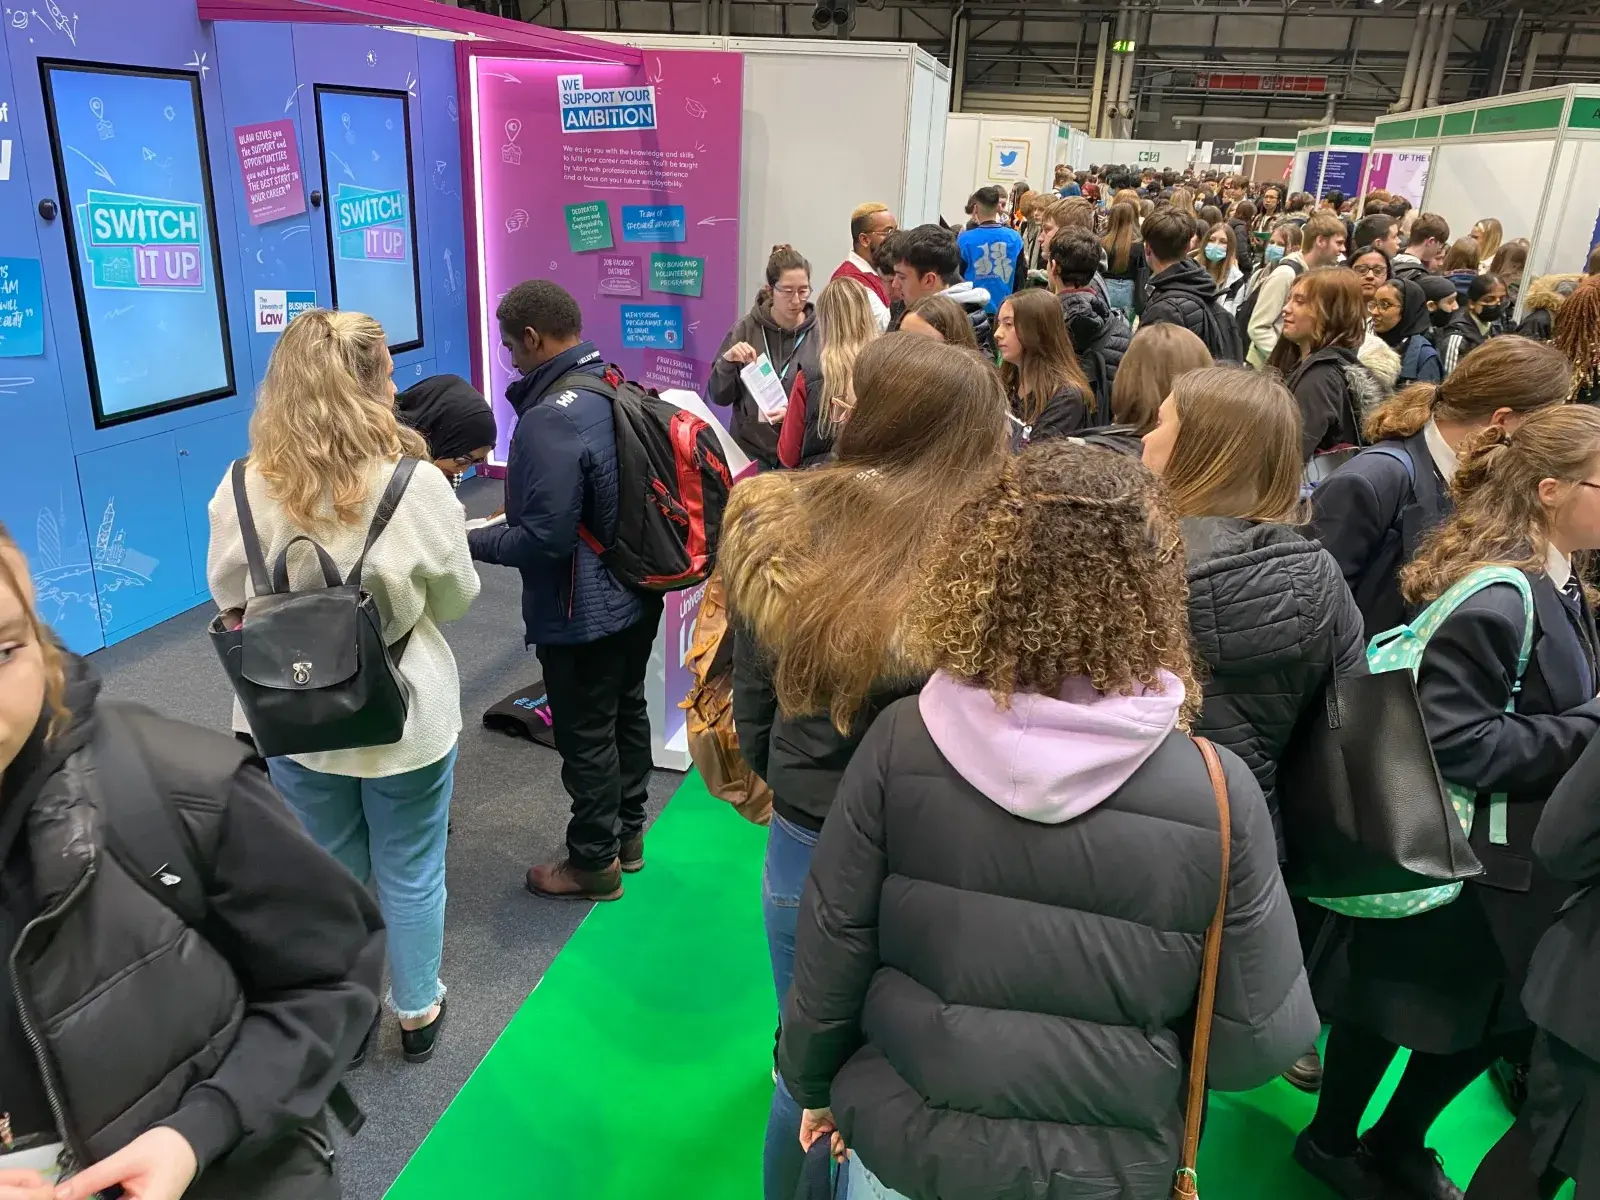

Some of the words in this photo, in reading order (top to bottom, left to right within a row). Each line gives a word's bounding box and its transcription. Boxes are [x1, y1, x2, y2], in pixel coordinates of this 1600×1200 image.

[562, 79, 580, 91] WE
[563, 91, 615, 105] SUPPORT
[618, 89, 650, 103] YOUR
[566, 107, 653, 128] AMBITION
[255, 130, 272, 141] GIVES
[273, 130, 282, 140] you
[241, 147, 251, 157] the
[251, 141, 276, 155] SUPPORT
[277, 139, 287, 149] and
[574, 146, 592, 154] equip
[605, 147, 617, 155] with
[630, 149, 663, 158] knowledge
[679, 151, 694, 159] skills
[244, 151, 287, 169] OPPORTUNITIES
[584, 156, 597, 164] your
[599, 157, 618, 165] career
[619, 158, 650, 166] ambitions.
[679, 162, 698, 170] taught
[1398, 154, 1409, 162] OF
[1411, 154, 1427, 162] THE
[247, 173, 256, 183] you
[257, 167, 269, 177] need
[270, 166, 276, 174] to
[276, 163, 290, 172] make
[602, 166, 638, 175] professional
[654, 170, 689, 179] experience
[248, 182, 259, 192] THE
[261, 179, 274, 190] BEST
[275, 173, 291, 185] START
[583, 174, 599, 182] focus
[623, 177, 641, 185] future
[250, 192, 266, 205] YOUR
[340, 193, 402, 227] SWITCH
[571, 205, 599, 215] DEDICATED
[591, 211, 601, 219] and
[94, 207, 197, 241] SWITCH
[571, 219, 604, 230] Employability
[580, 228, 600, 236] Services
[366, 229, 380, 253] IT
[382, 231, 402, 254] UP
[139, 249, 159, 279] IT
[164, 251, 197, 280] UP
[603, 258, 612, 267] JOB
[612, 259, 635, 267] VACANCY
[654, 261, 666, 269] PRO
[684, 260, 698, 268] AND
[607, 267, 631, 276] DATABASE
[655, 270, 699, 278] VOLUNTEERING
[660, 278, 696, 287] PROGRAMME
[259, 296, 268, 304] The
[288, 302, 314, 311] BUSINESS
[260, 311, 283, 325] Law
[625, 319, 662, 327] PROGRAMME
[663, 319, 677, 327] AND
[576, 354, 592, 365] HELLY
[656, 355, 693, 371] PROFESSIONAL
[655, 364, 693, 379] DEVELOPMENT
[646, 371, 670, 383] SESSIONS
[681, 380, 701, 391] EVENTS
